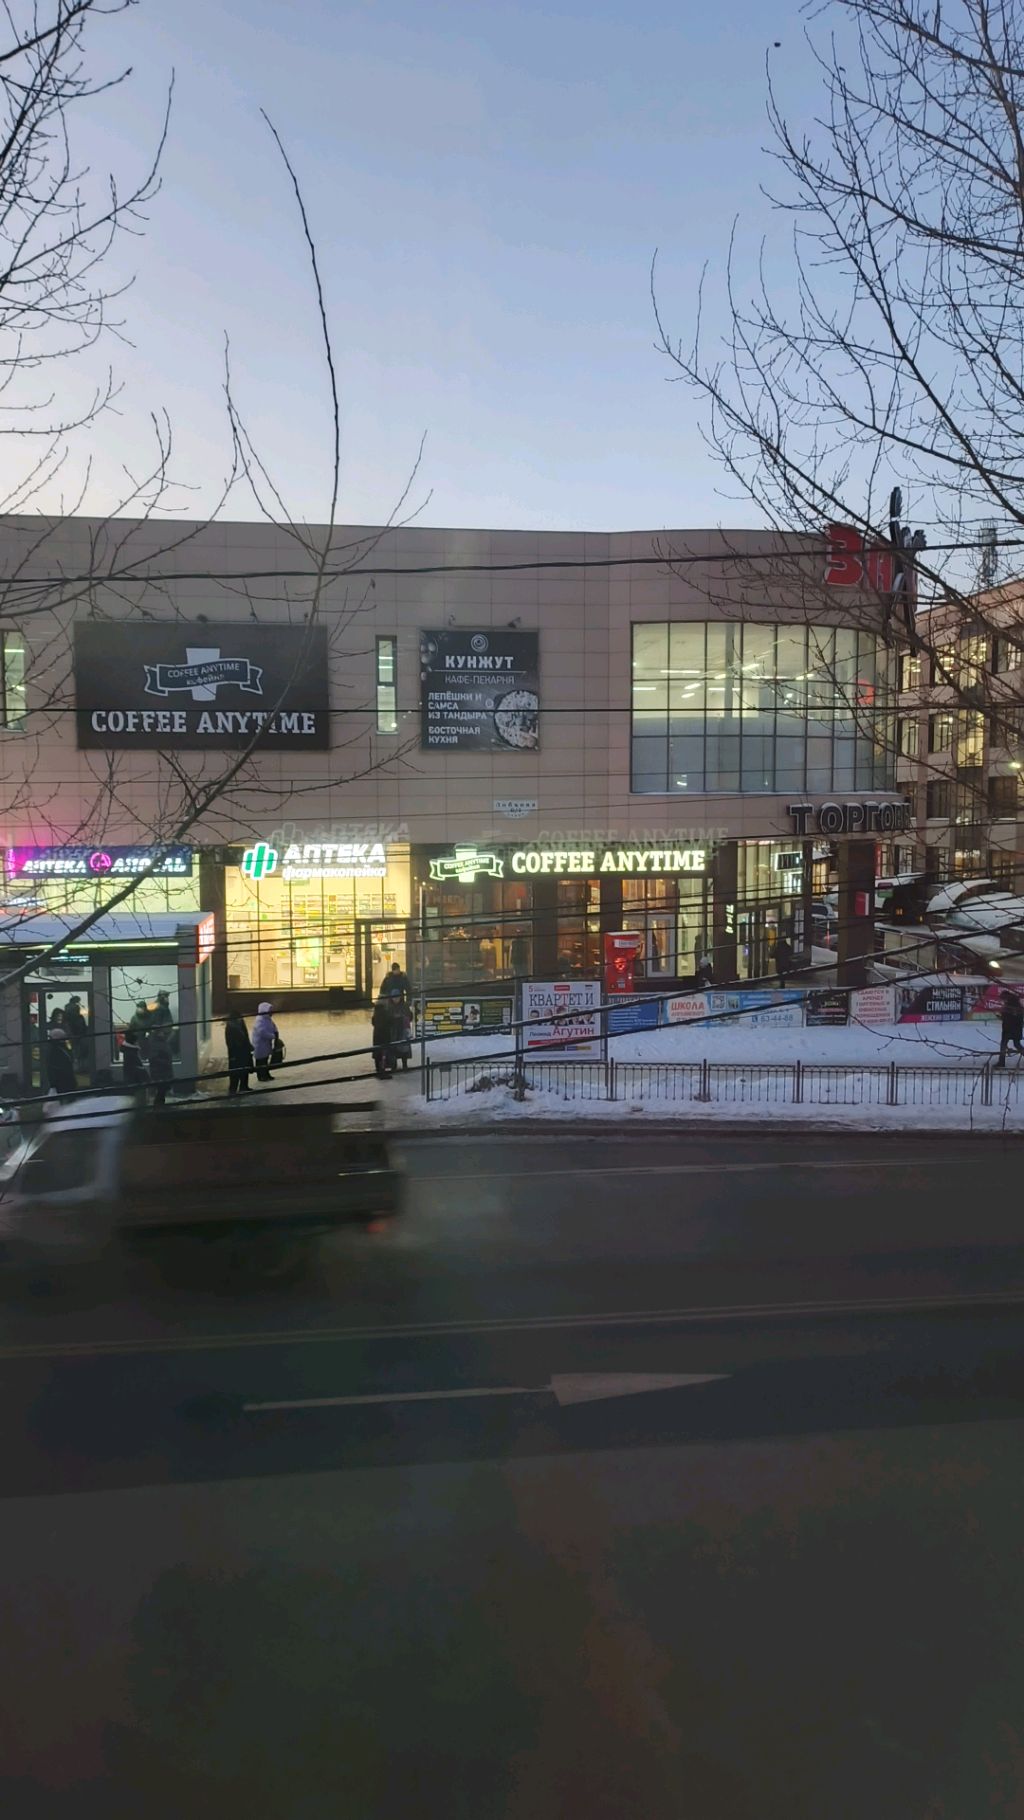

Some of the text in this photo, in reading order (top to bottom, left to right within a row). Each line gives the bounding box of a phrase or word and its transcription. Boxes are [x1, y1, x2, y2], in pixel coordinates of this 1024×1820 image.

[445, 655, 514, 669] КУНЖУТ
[167, 662, 240, 678] COFFEE ANYTIME
[444, 675, 515, 685] КАФЕ-ПЕКАРНЯ
[428, 691, 473, 701] ЛЕПЁШКИ
[428, 702, 459, 710] САМСА
[428, 711, 488, 720] ИЗ ТАНДЫРА
[91, 710, 316, 735] COFFEE ANYTIME
[428, 726, 481, 735] ВОСТОЧНАЯ
[428, 735, 458, 744] КУХНЯ
[282, 843, 386, 864] АПТЕКА
[22, 859, 87, 873] АПТЕКА
[511, 850, 706, 873] COFFEE ANYTIME
[529, 993, 583, 1007] КВАРТЕТ
[585, 993, 594, 1005] И
[671, 1001, 705, 1011] ШКОЛА
[552, 1026, 595, 1038] Агутин
